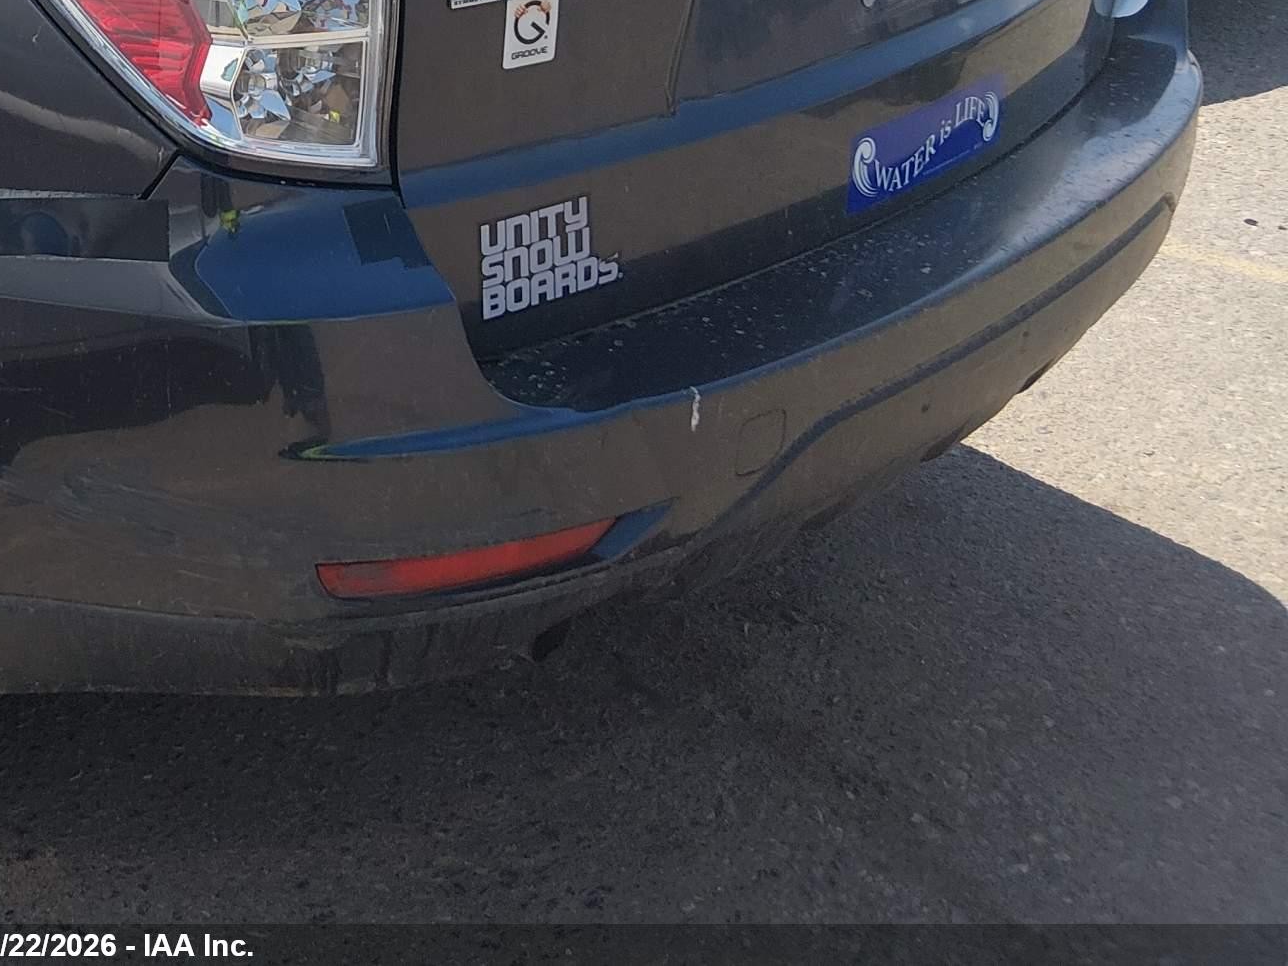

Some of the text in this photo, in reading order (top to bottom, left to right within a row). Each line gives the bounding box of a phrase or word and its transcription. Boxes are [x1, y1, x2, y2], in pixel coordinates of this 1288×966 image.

[511, 46, 549, 60] GROOVE
[874, 134, 937, 192] WATER
[939, 119, 952, 146] is
[954, 96, 986, 128] LIFE
[480, 196, 588, 256] UNITY
[481, 227, 591, 288] SNOW
